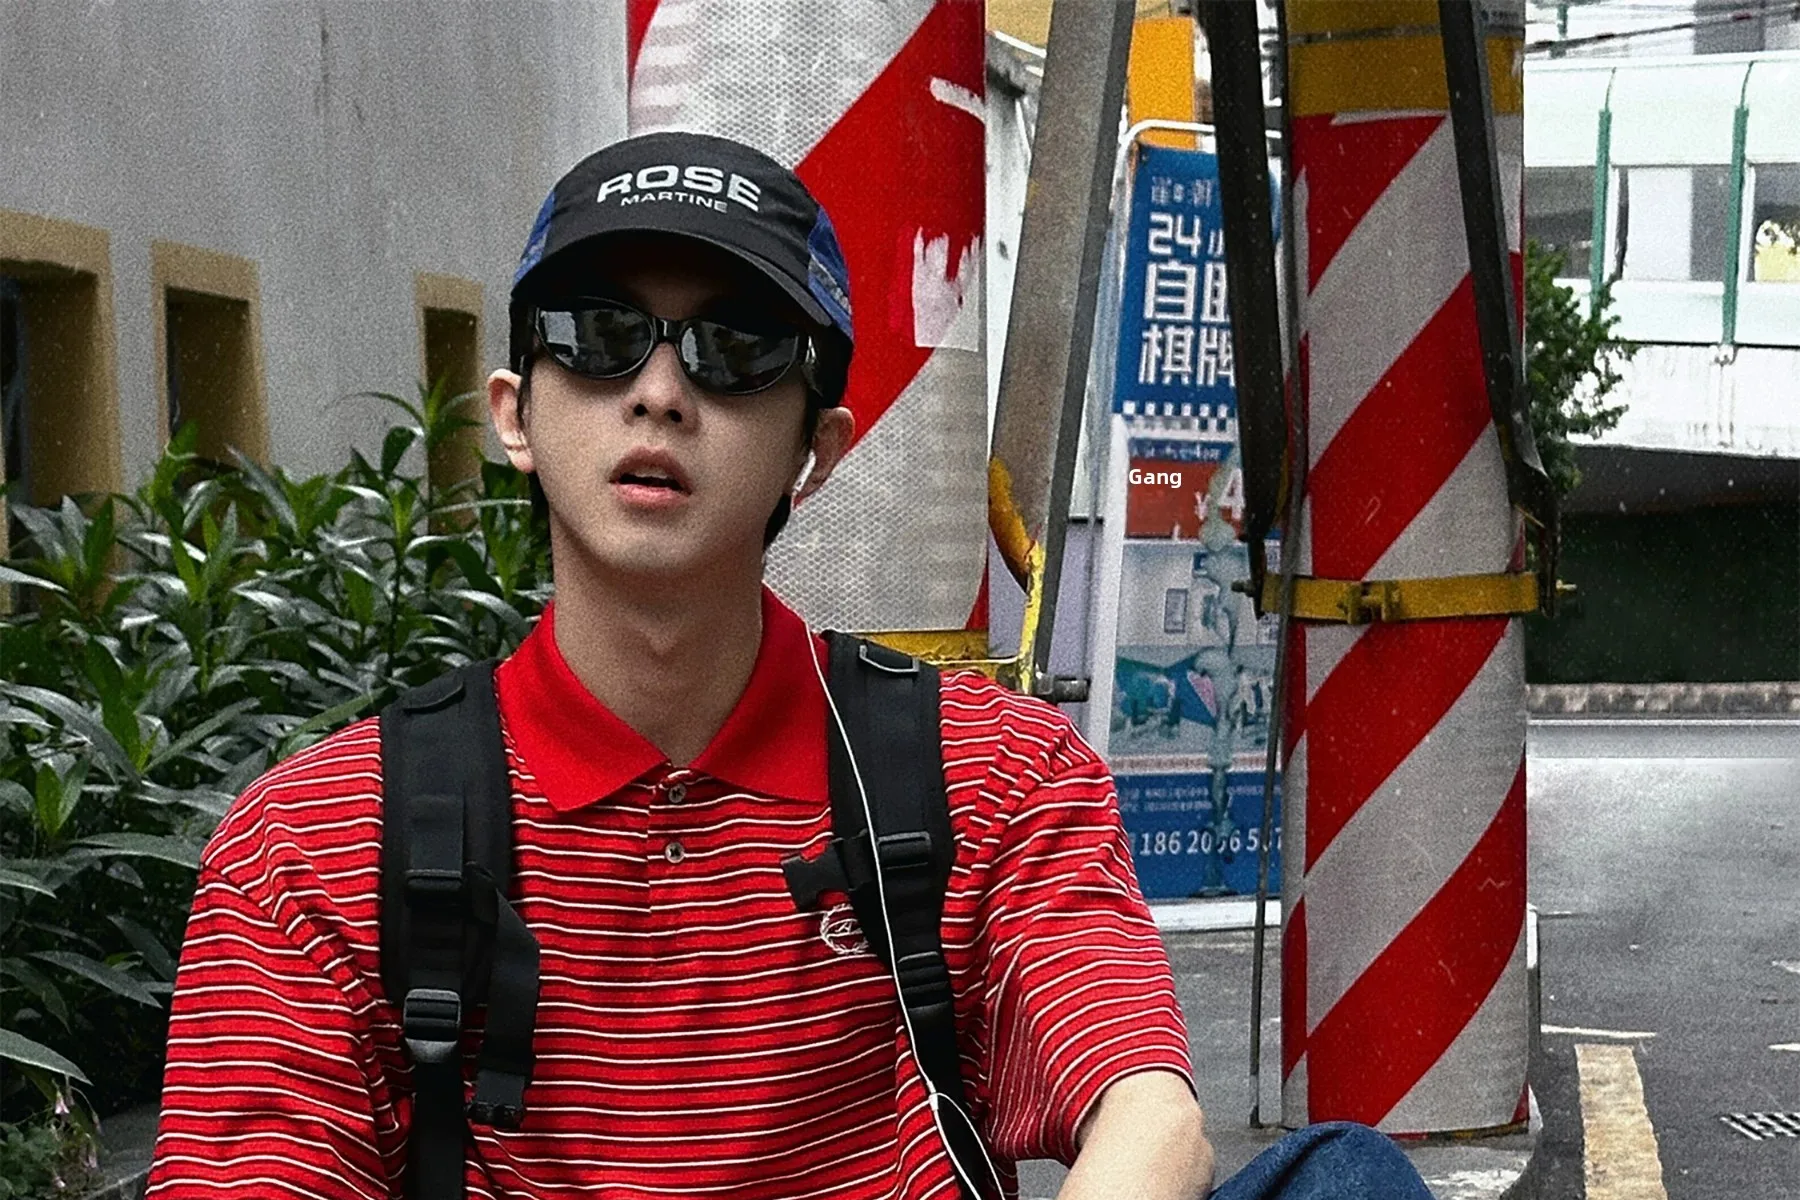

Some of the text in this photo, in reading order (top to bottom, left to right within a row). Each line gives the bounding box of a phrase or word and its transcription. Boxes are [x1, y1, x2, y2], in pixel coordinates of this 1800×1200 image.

[597, 165, 761, 212] ROSE
[621, 191, 728, 213] MARTINE
[1139, 830, 1181, 856] 186
